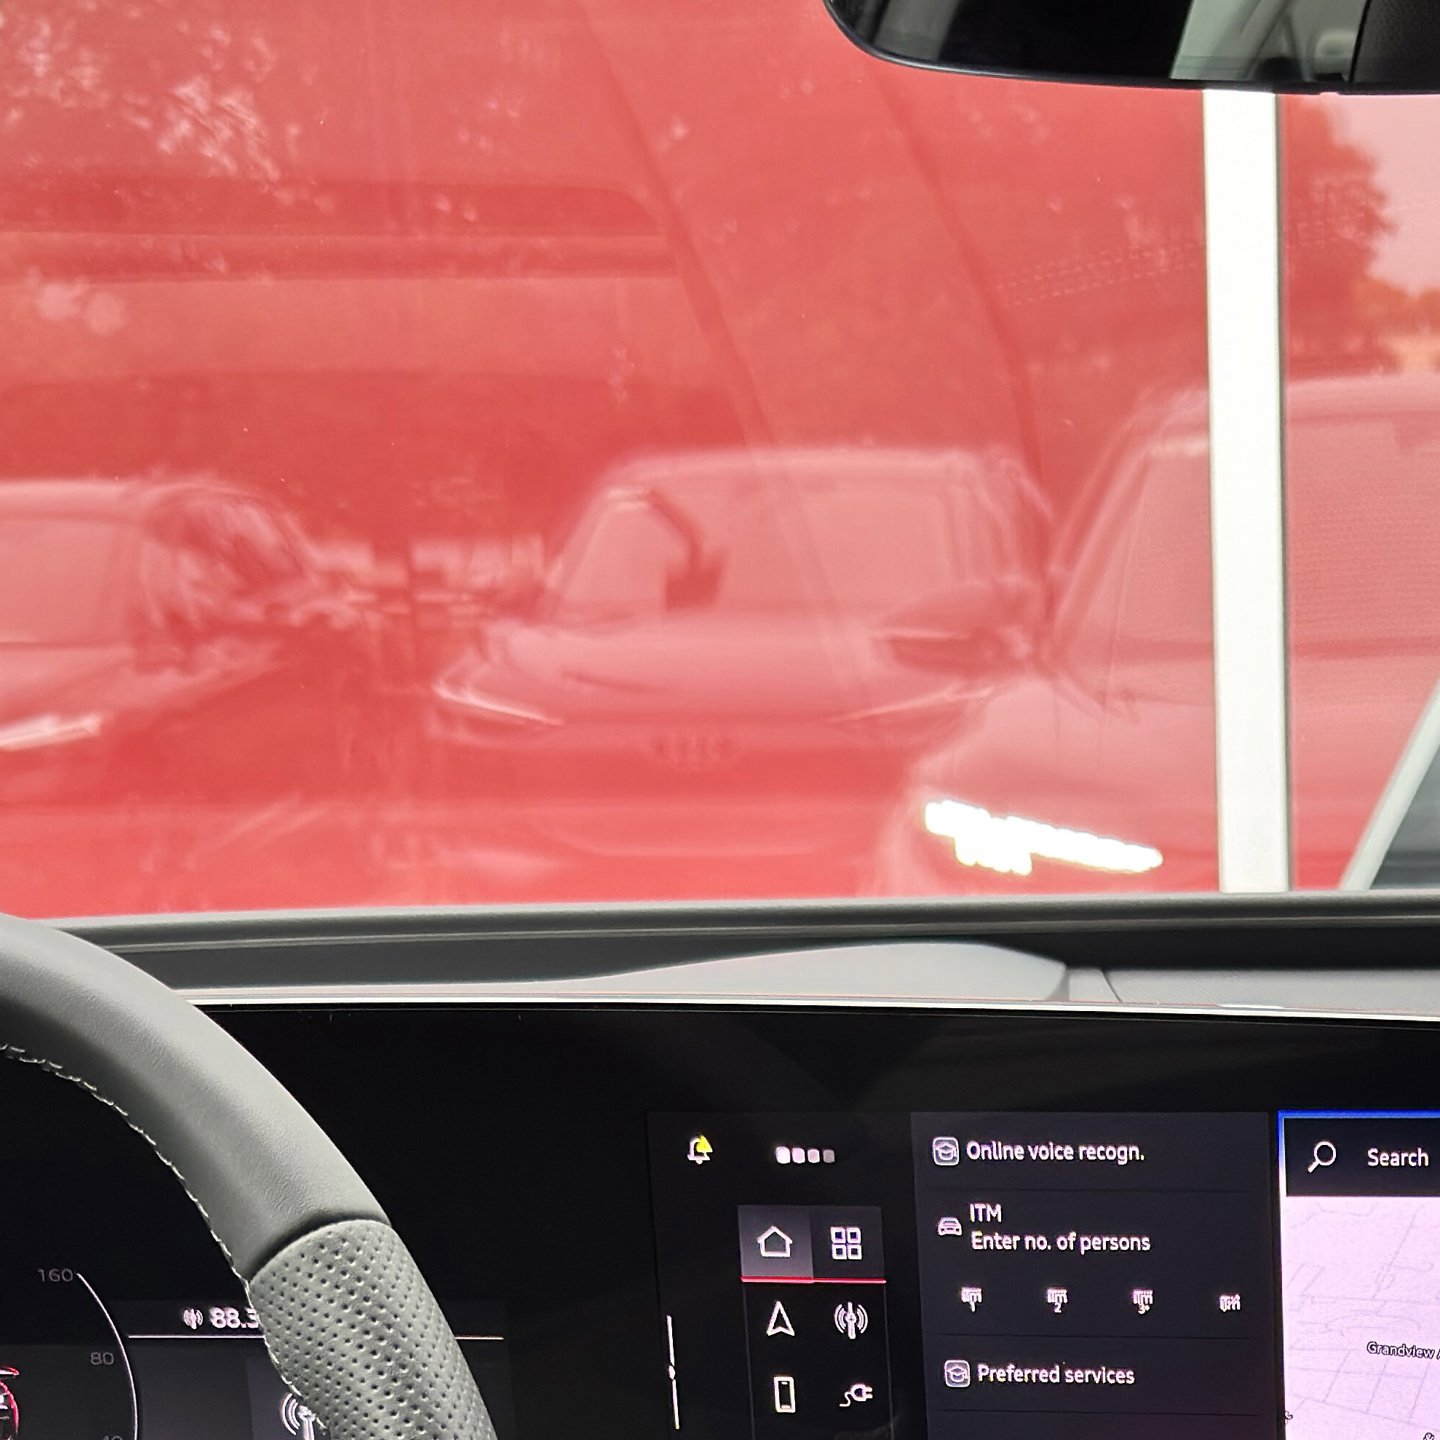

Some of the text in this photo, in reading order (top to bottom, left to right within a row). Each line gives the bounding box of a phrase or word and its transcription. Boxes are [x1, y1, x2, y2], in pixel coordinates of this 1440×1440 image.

[966, 1141, 1145, 1165] Online voice recogn.
[1367, 1147, 1429, 1167] Search
[969, 1203, 1002, 1223] ITM
[970, 1231, 1151, 1255] Enter no. of persons
[38, 1268, 74, 1282] 160
[209, 1307, 260, 1328] 88.3
[90, 1352, 114, 1365] 80
[1366, 1341, 1435, 1360] Grandview
[977, 1363, 1135, 1385] Preferred services
